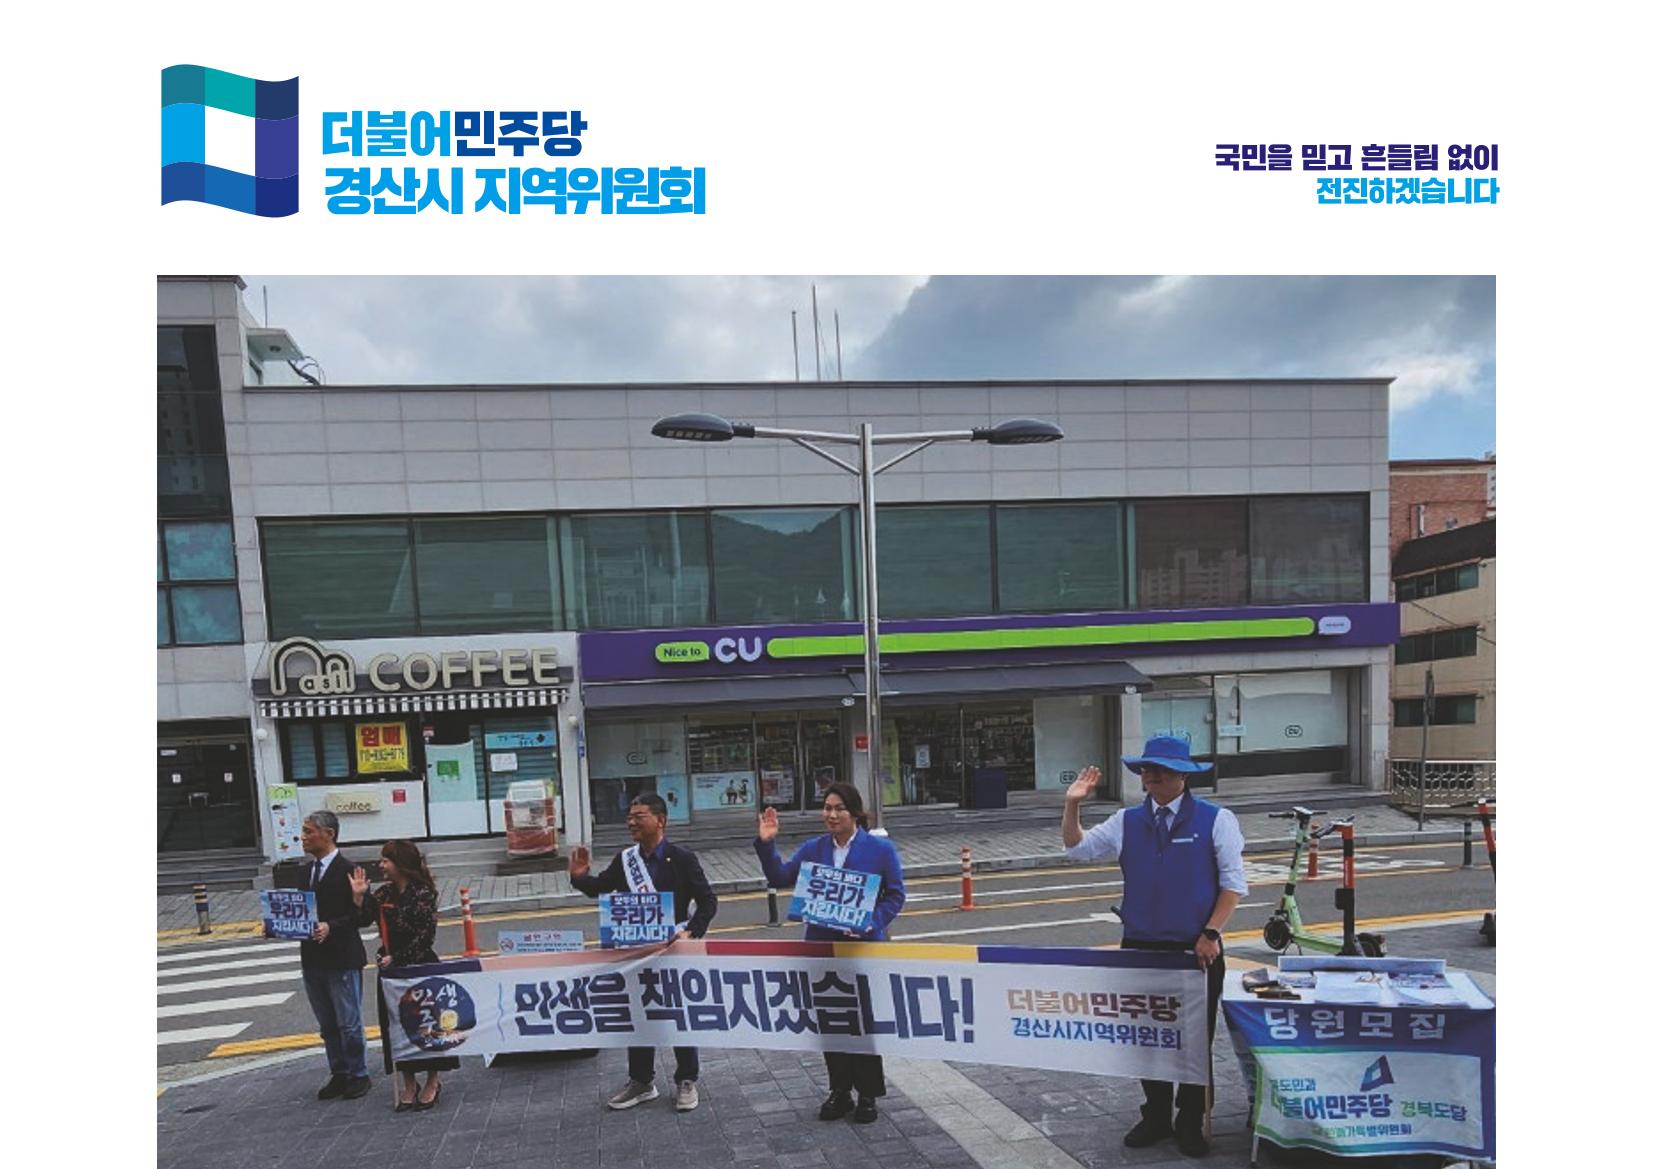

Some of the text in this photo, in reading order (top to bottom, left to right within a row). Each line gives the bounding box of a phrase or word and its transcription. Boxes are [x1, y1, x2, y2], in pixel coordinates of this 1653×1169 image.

[663, 637, 763, 663] Nice to CU
[369, 648, 561, 691] COFFEE
[807, 879, 865, 908] 우리가
[270, 902, 309, 919] 우리가
[611, 905, 664, 926] 우리가
[514, 968, 975, 1043] 민생을 책임지겠습니다!
[1007, 988, 1182, 1023] 더불어민주당
[1010, 1017, 1183, 1050] 경산시지역위원회
[1263, 1007, 1446, 1040] 당원모집
[1401, 1101, 1468, 1122] 경북도당
